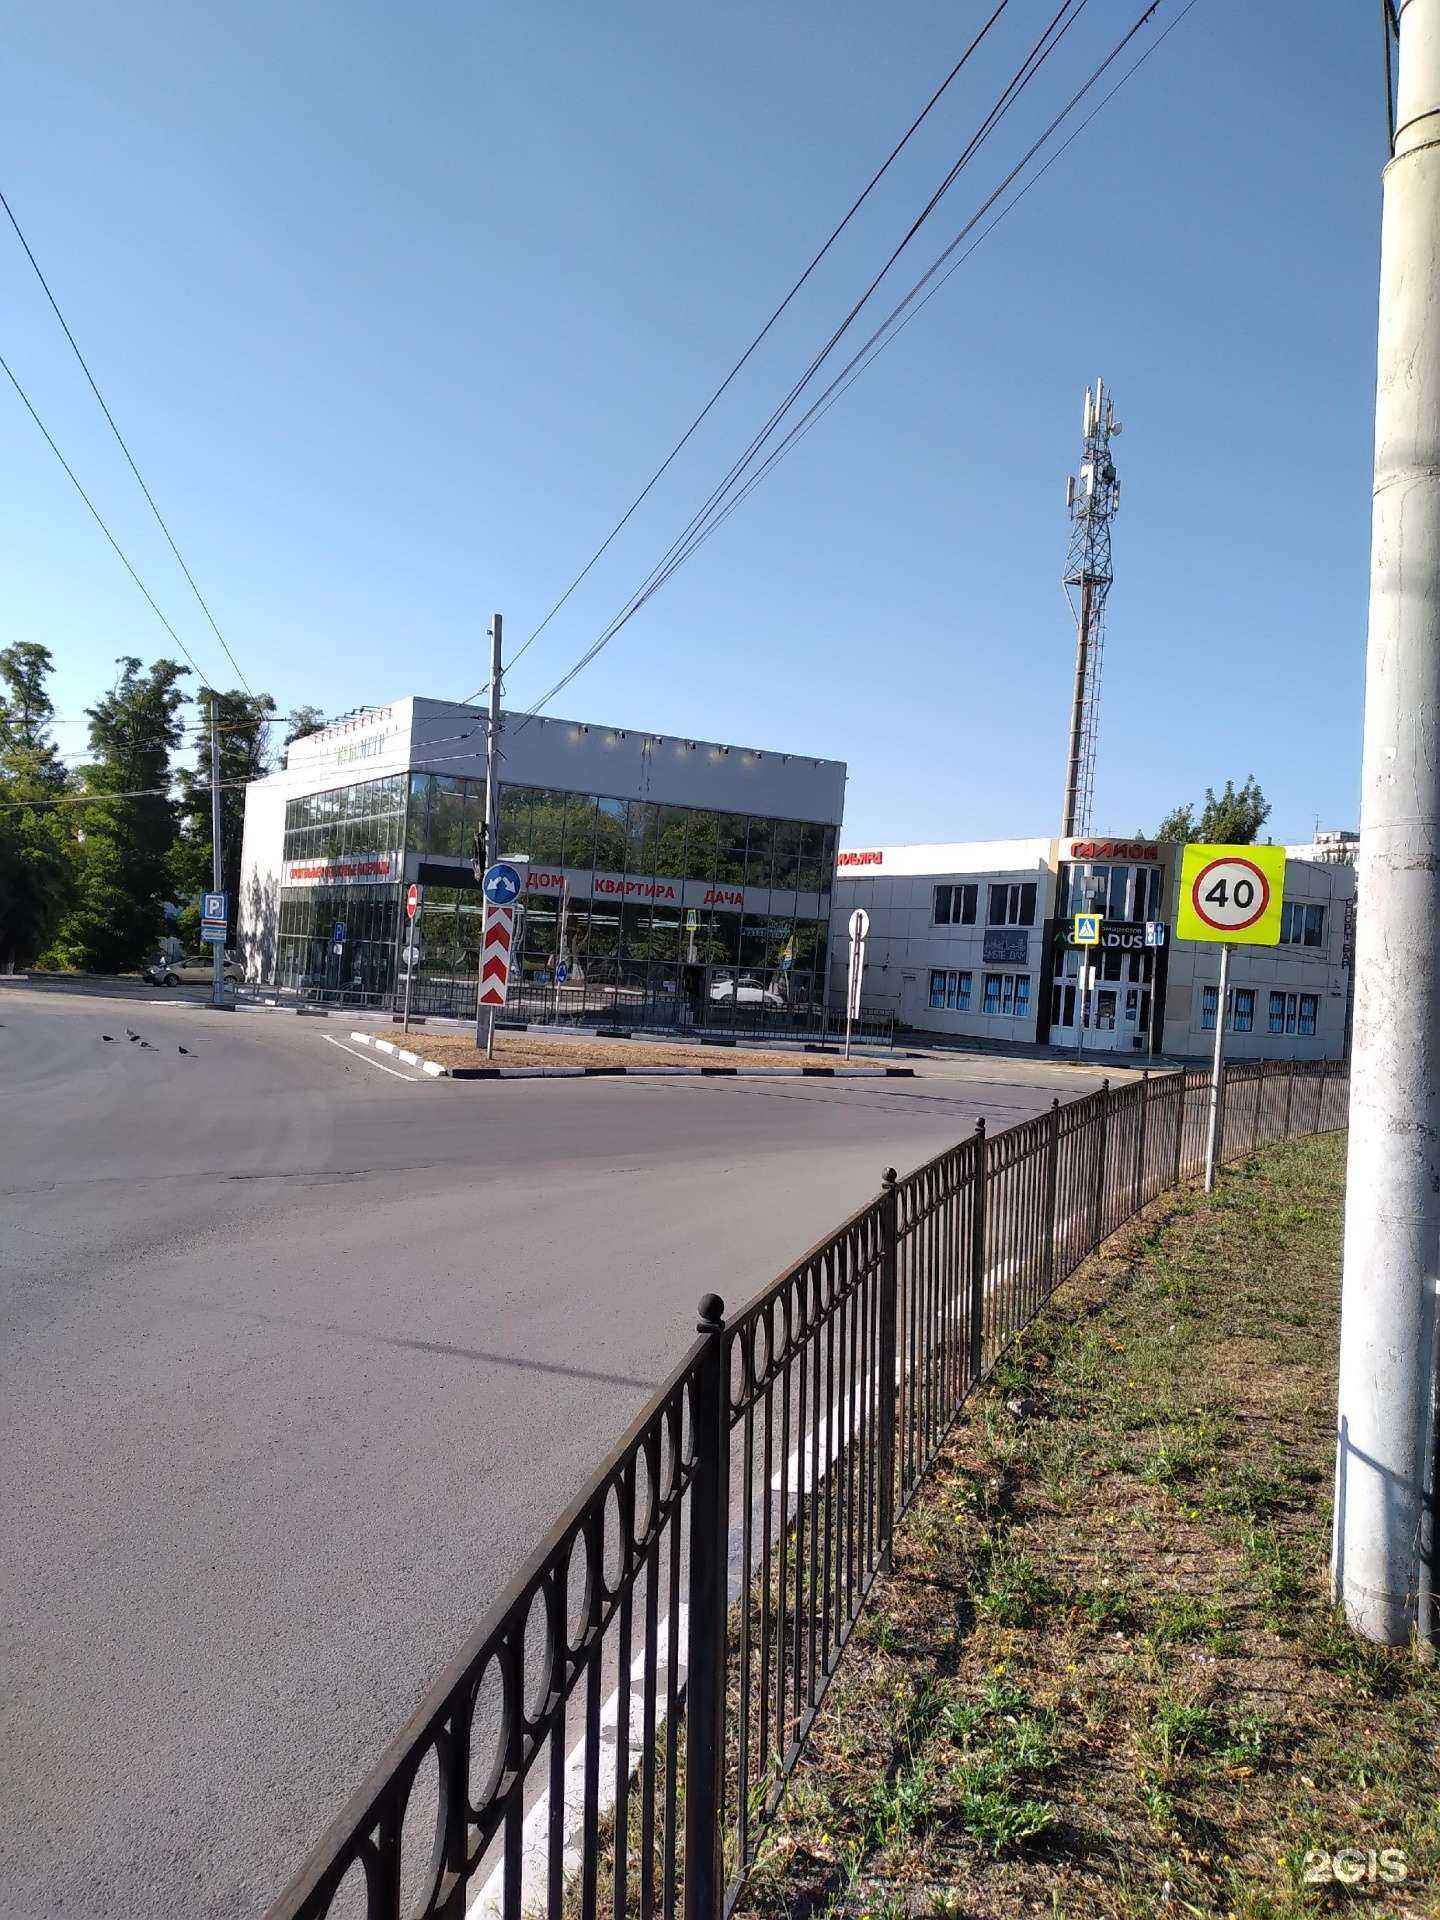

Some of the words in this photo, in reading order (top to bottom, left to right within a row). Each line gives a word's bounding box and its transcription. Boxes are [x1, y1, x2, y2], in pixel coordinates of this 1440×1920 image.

[836, 851, 883, 866] ИЛЬЯРД
[525, 872, 566, 889] ДОМ
[594, 878, 676, 899] КВАРТИРА
[703, 889, 743, 905] ДАЧА
[1205, 878, 1254, 908] 40
